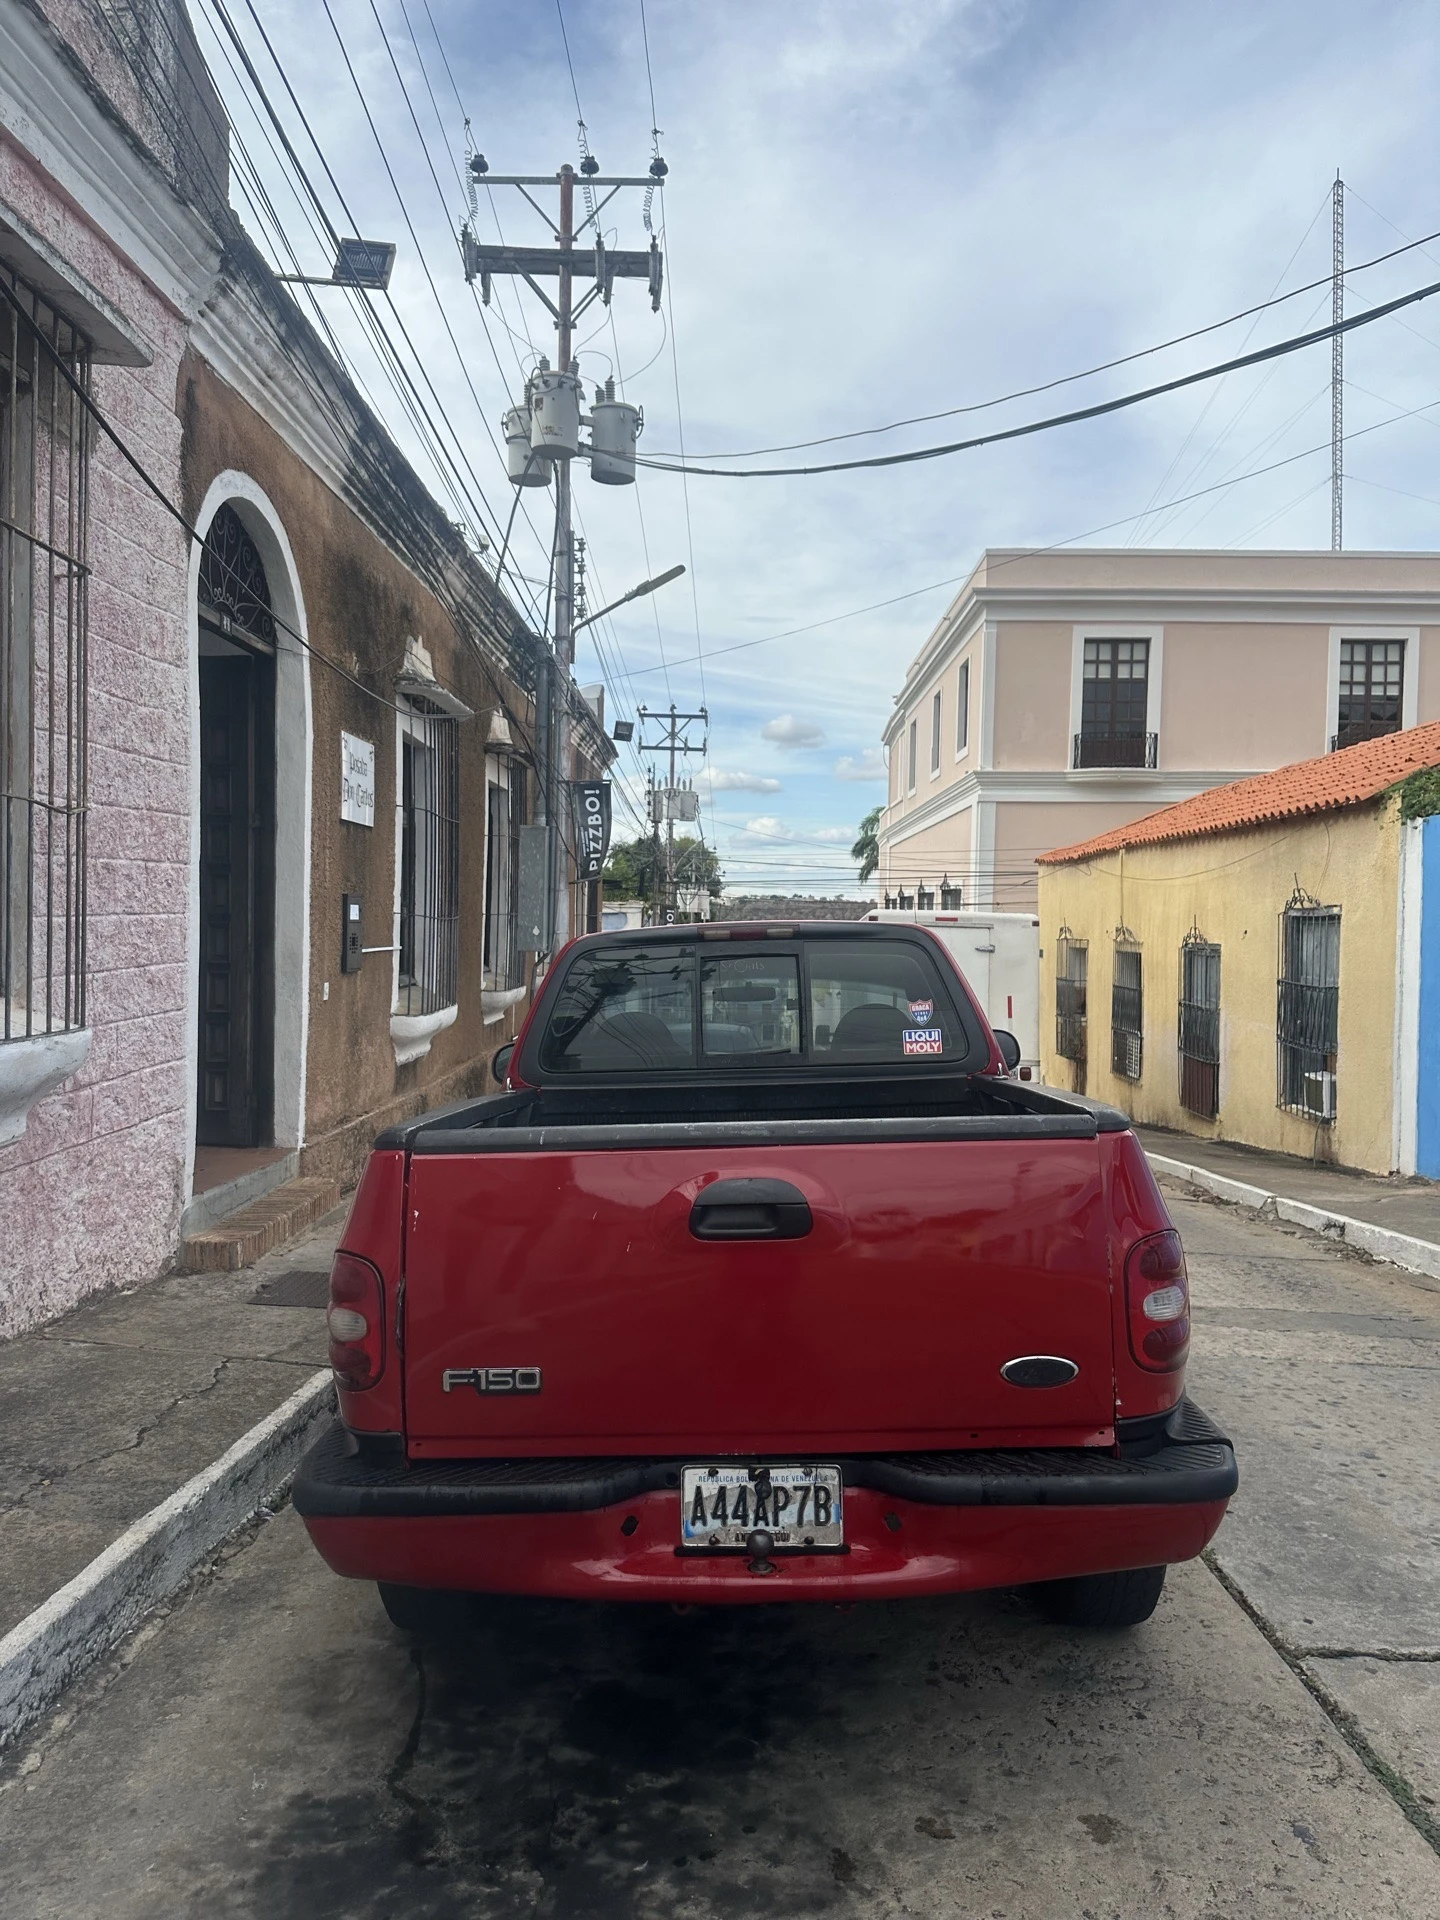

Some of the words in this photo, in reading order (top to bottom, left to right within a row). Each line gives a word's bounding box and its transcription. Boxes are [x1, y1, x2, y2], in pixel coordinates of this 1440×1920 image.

[584, 789, 602, 871] PIZZBO!
[905, 1030, 939, 1042] LIQUI
[906, 1042, 940, 1053] MOLY
[690, 1484, 832, 1528] A44AP7B
